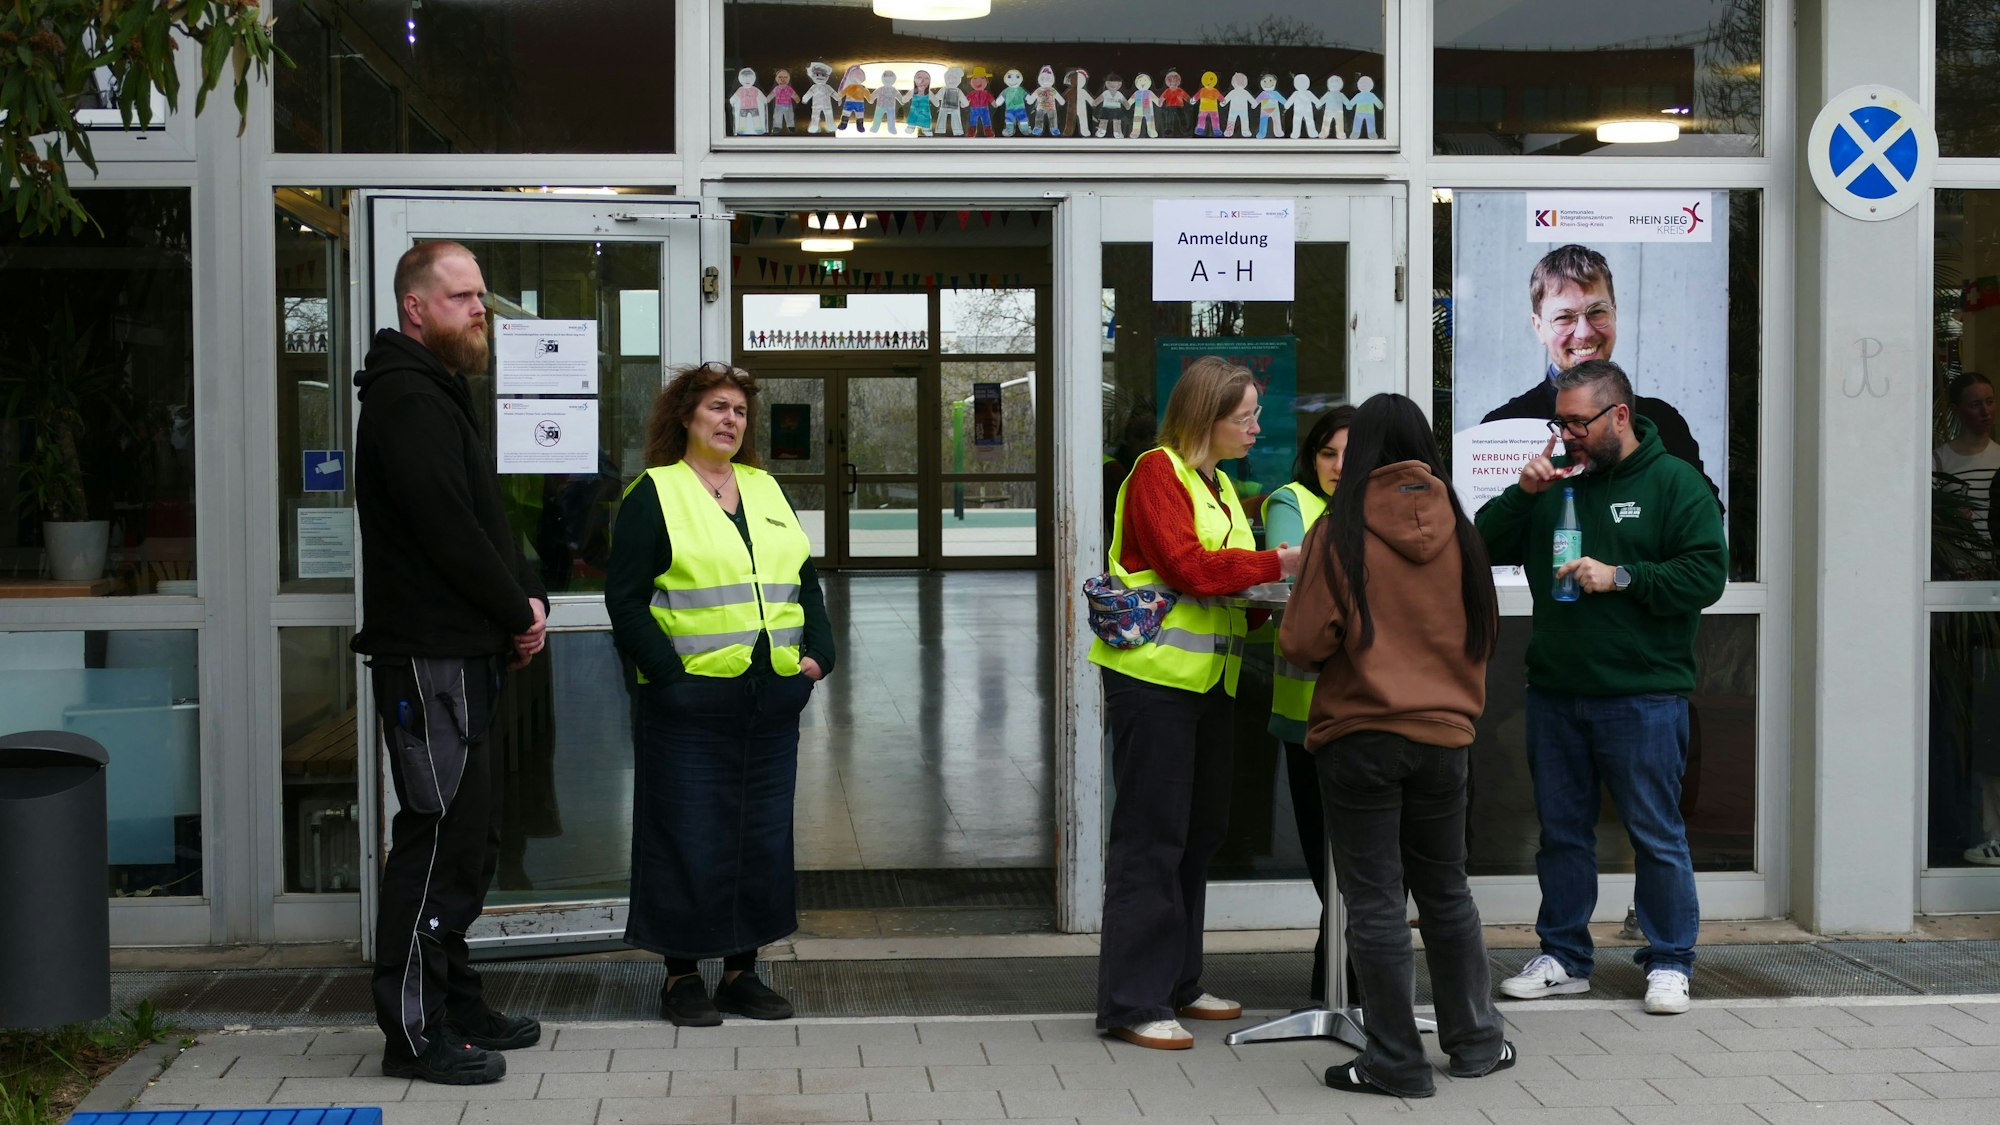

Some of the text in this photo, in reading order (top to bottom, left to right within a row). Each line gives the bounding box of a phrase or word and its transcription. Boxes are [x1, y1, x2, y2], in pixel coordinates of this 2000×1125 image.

[1535, 210, 1557, 226] KI
[1629, 216, 1688, 224] RHEIN SIEG
[1656, 226, 1685, 234] KREIS
[1178, 231, 1268, 248] Anmeldung
[1190, 260, 1209, 282] A
[1236, 260, 1252, 282] H
